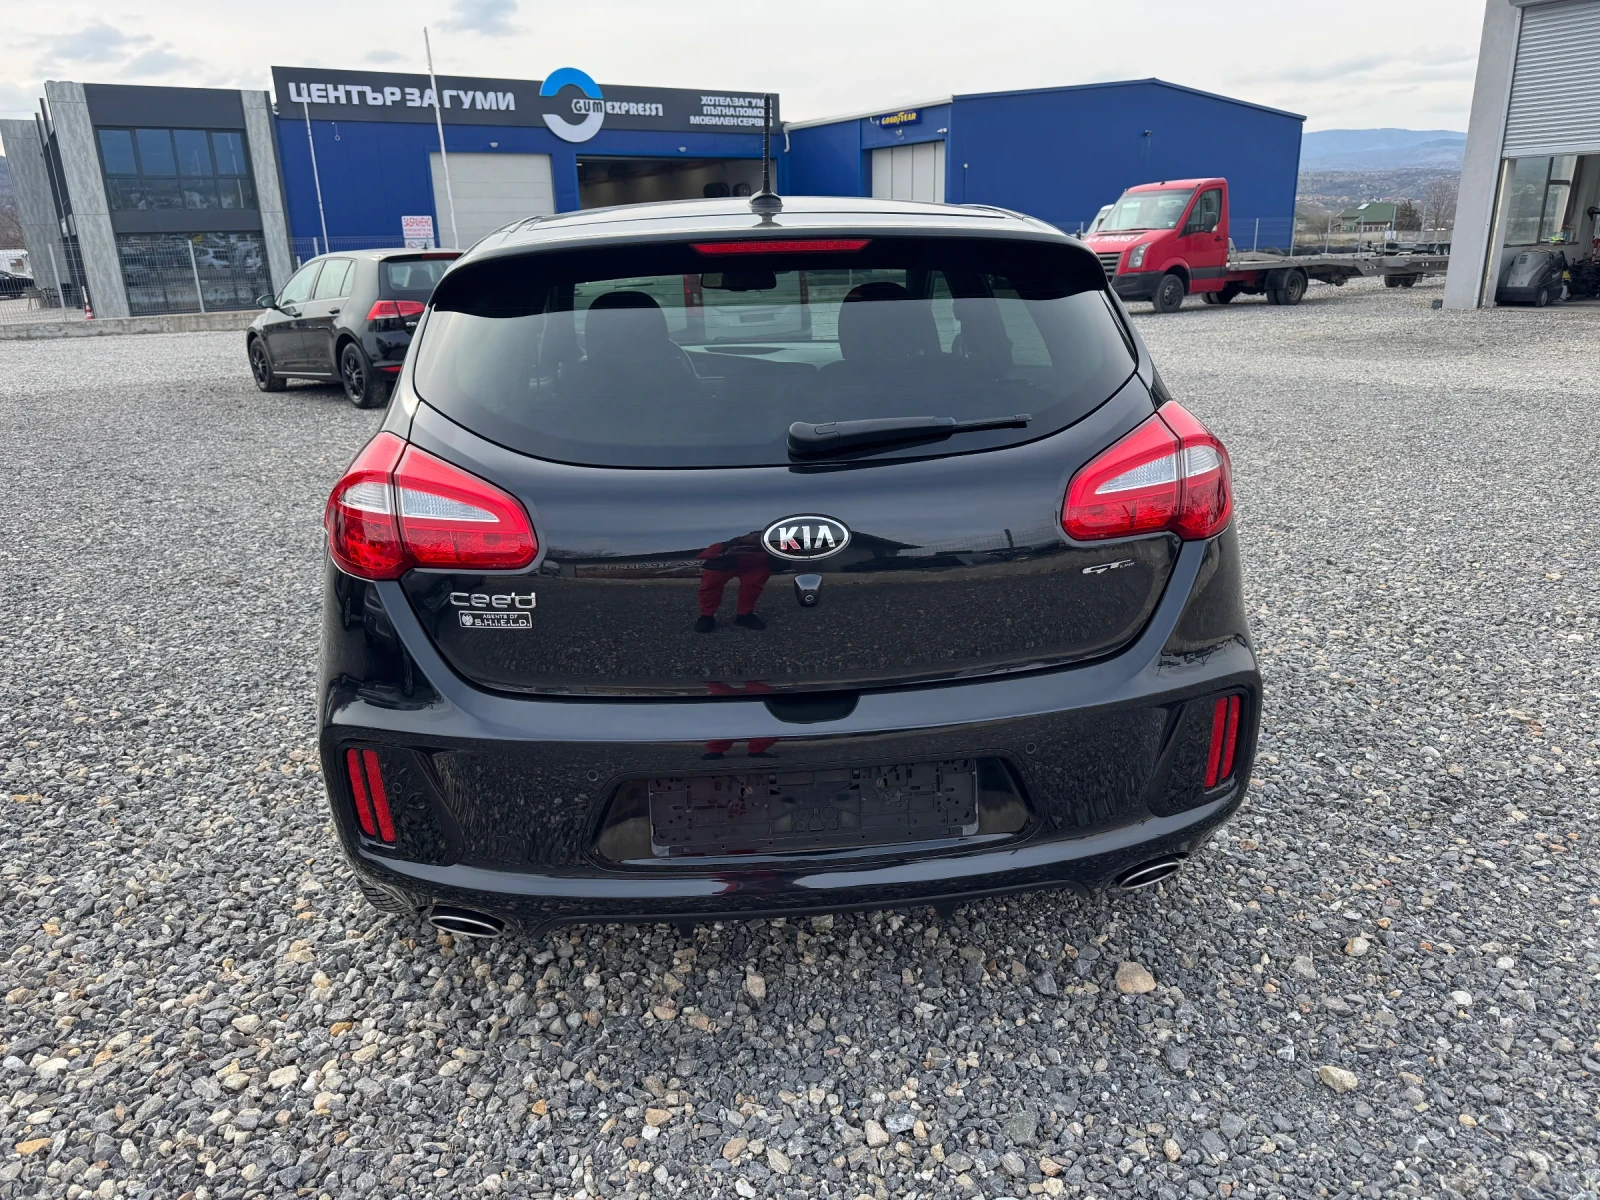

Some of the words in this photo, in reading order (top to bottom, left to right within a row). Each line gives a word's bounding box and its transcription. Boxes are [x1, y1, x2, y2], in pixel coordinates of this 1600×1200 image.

[288, 82, 401, 106] ЦЕНТЪР
[405, 88, 440, 107] ЗА
[442, 89, 516, 111] ГУМИ
[700, 96, 732, 105] ХОТЕЛ
[732, 97, 745, 106] ЗА
[745, 98, 772, 107] ГУМ
[573, 100, 603, 113] GUM
[703, 106, 736, 115] ПЪТНА
[736, 107, 773, 117] ПОМО
[689, 116, 737, 126] МОБИЛЕН
[881, 111, 917, 125] GOODYEAR
[778, 524, 836, 551] KIA
[1082, 559, 1131, 574] GT
[474, 618, 531, 627] S.H.I.E.L.D.
